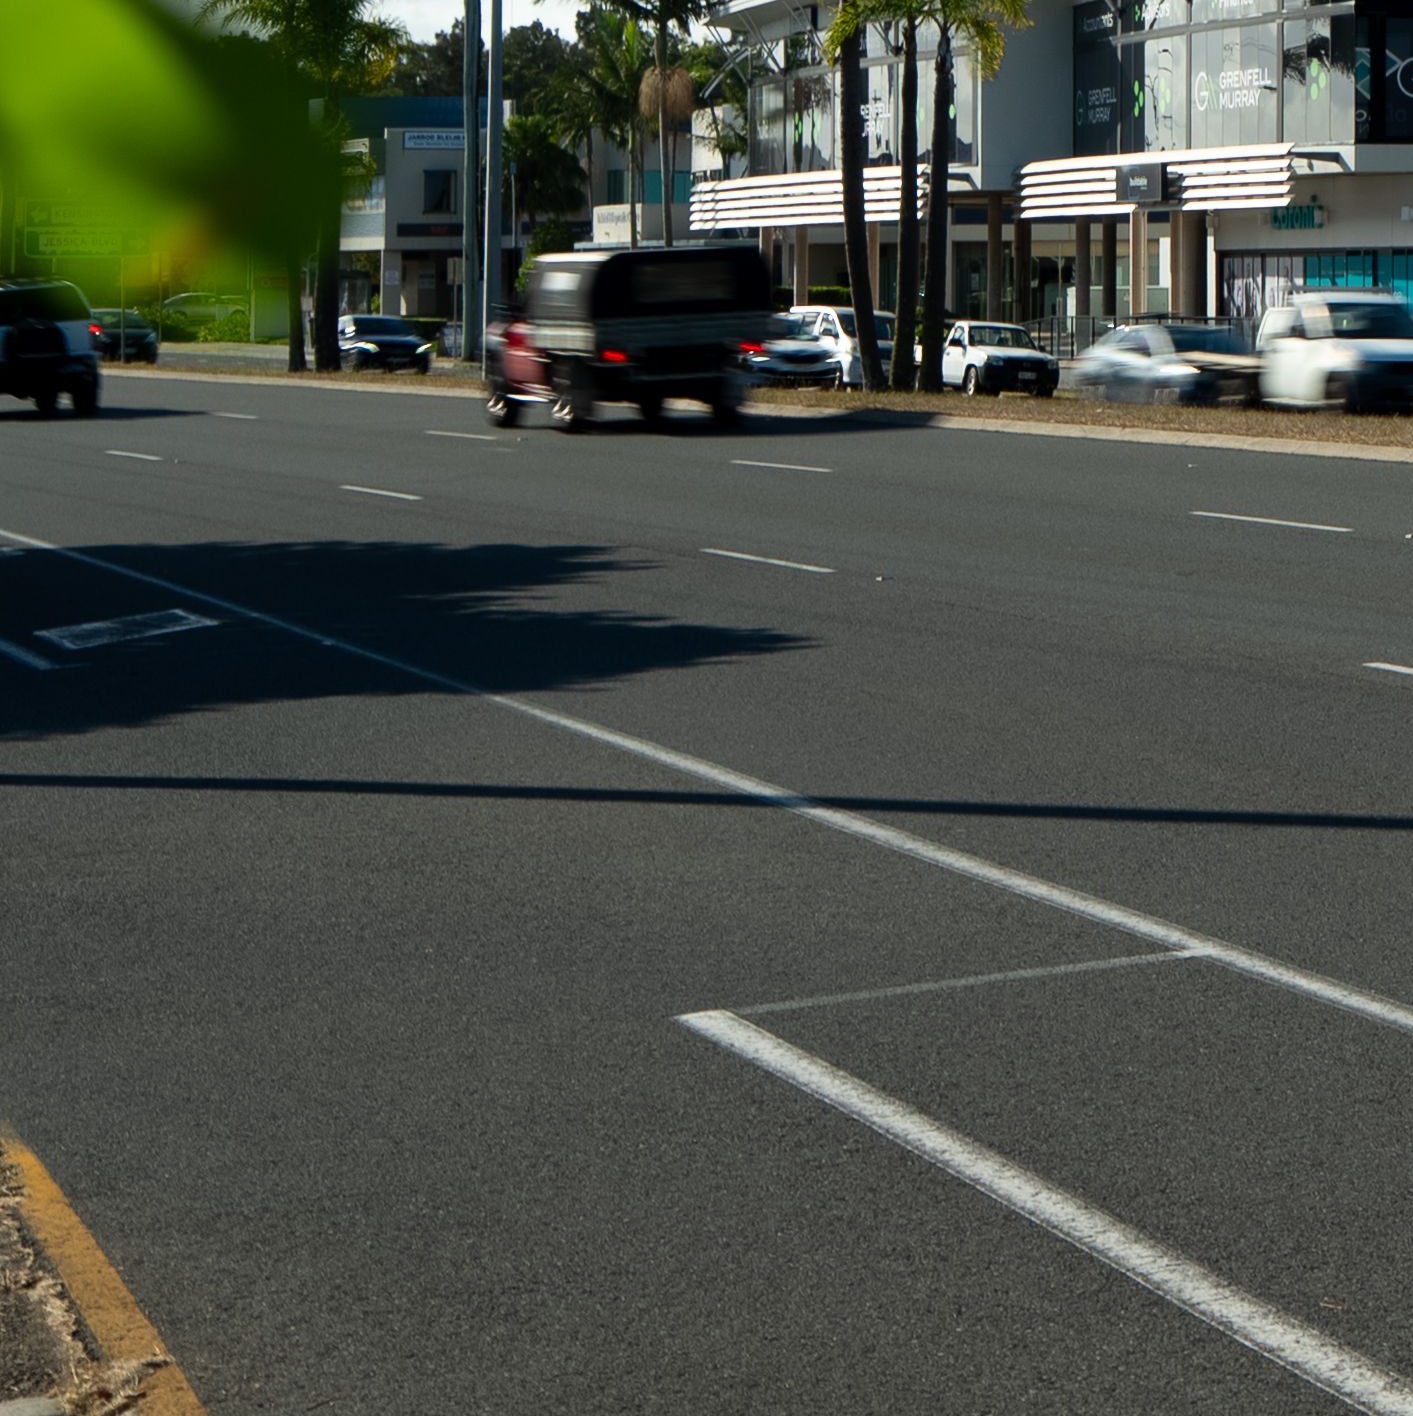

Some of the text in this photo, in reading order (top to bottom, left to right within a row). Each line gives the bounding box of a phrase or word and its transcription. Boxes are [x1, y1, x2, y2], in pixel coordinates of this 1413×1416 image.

[1218, 67, 1272, 90] GRENFELL
[1218, 89, 1261, 110] MURRAY
[860, 103, 892, 119] RENFELL
